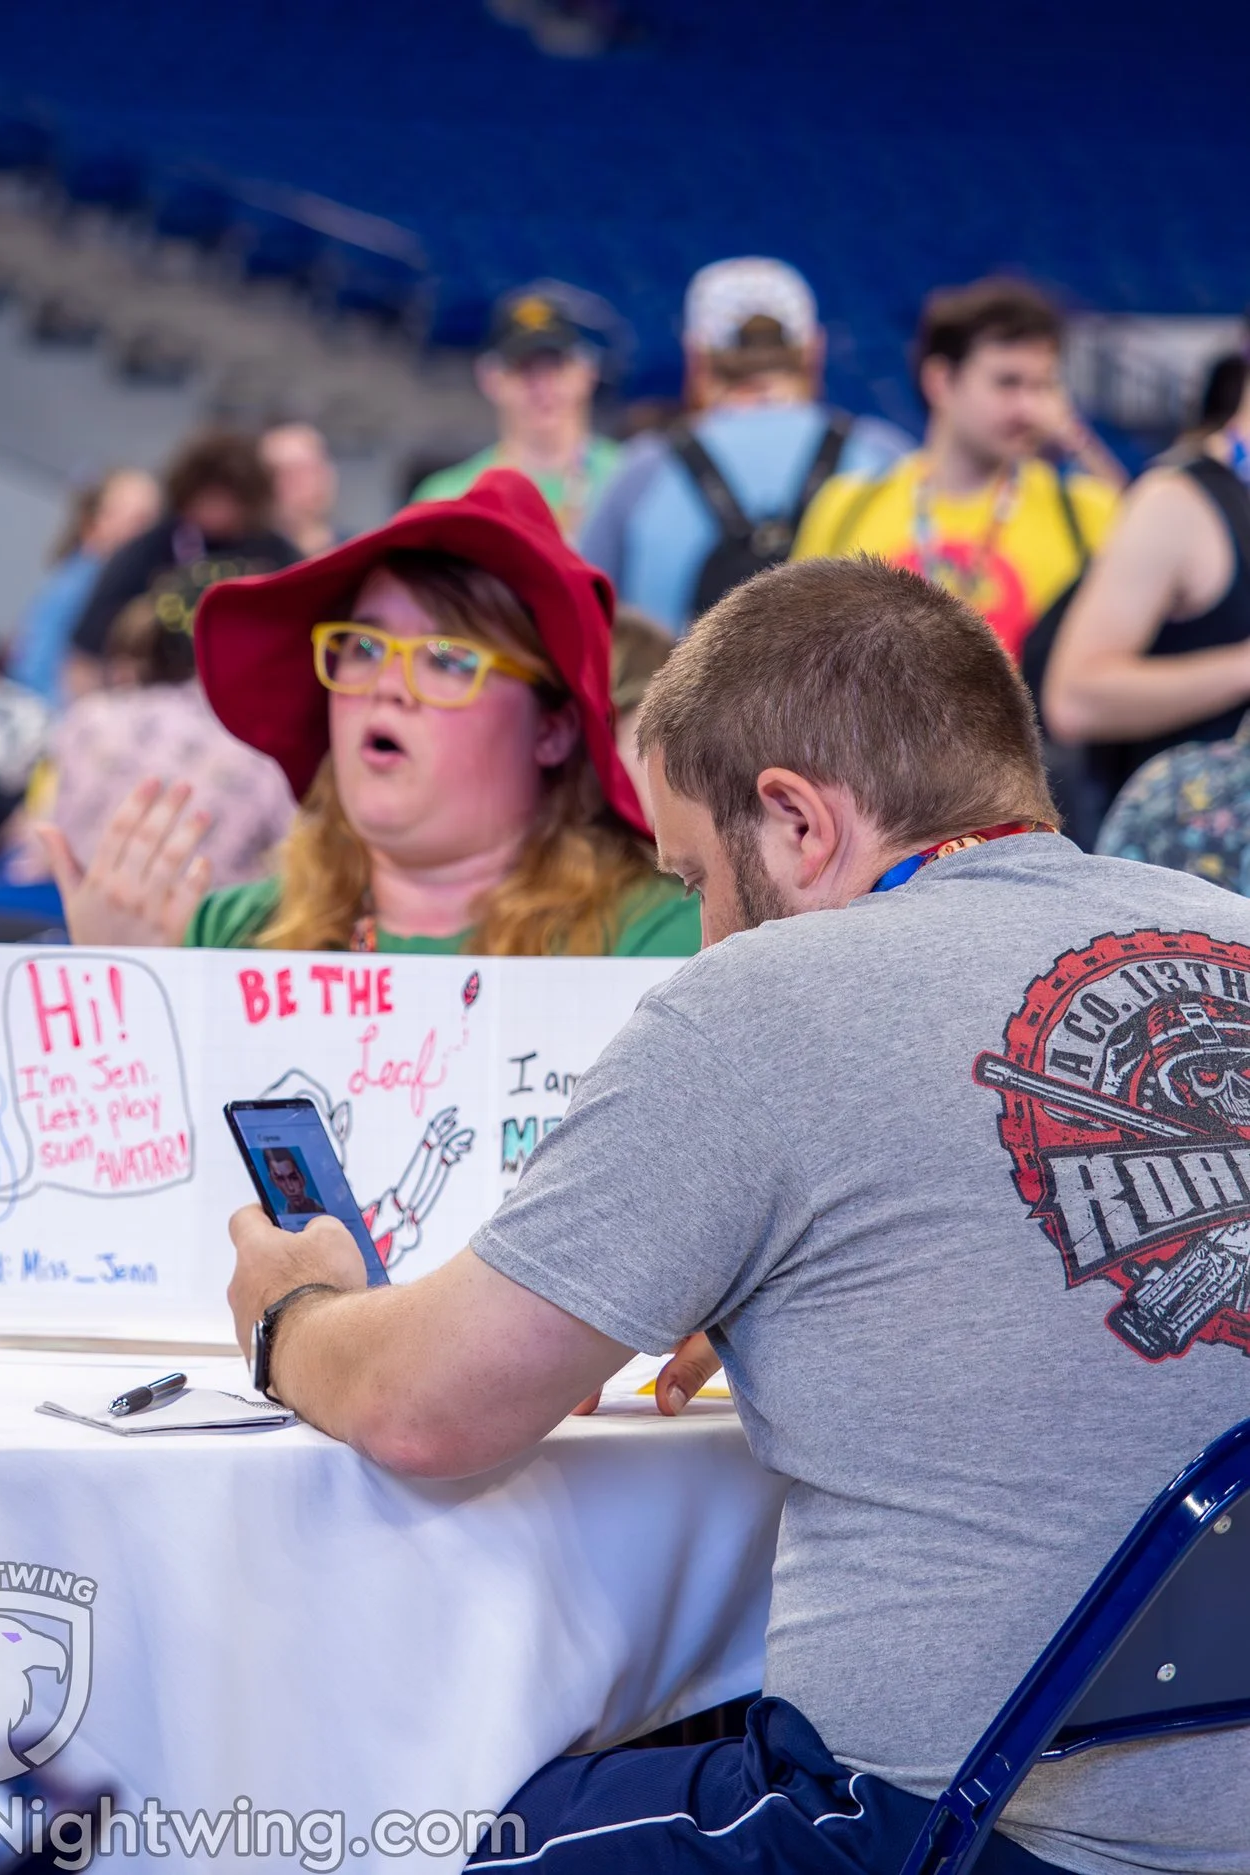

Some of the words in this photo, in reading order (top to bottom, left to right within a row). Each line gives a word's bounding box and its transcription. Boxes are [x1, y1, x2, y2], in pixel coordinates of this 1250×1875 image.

[25, 961, 129, 1053] Hi!
[238, 966, 298, 1025] BE
[309, 965, 394, 1016] THE
[17, 1066, 78, 1102] I'm
[349, 1023, 448, 1117] Leaf
[507, 1051, 539, 1096] I
[1050, 1047, 1094, 1081] A
[36, 1098, 99, 1133] Let's
[107, 1093, 162, 1140] play
[93, 1132, 190, 1190] AVATAR!
